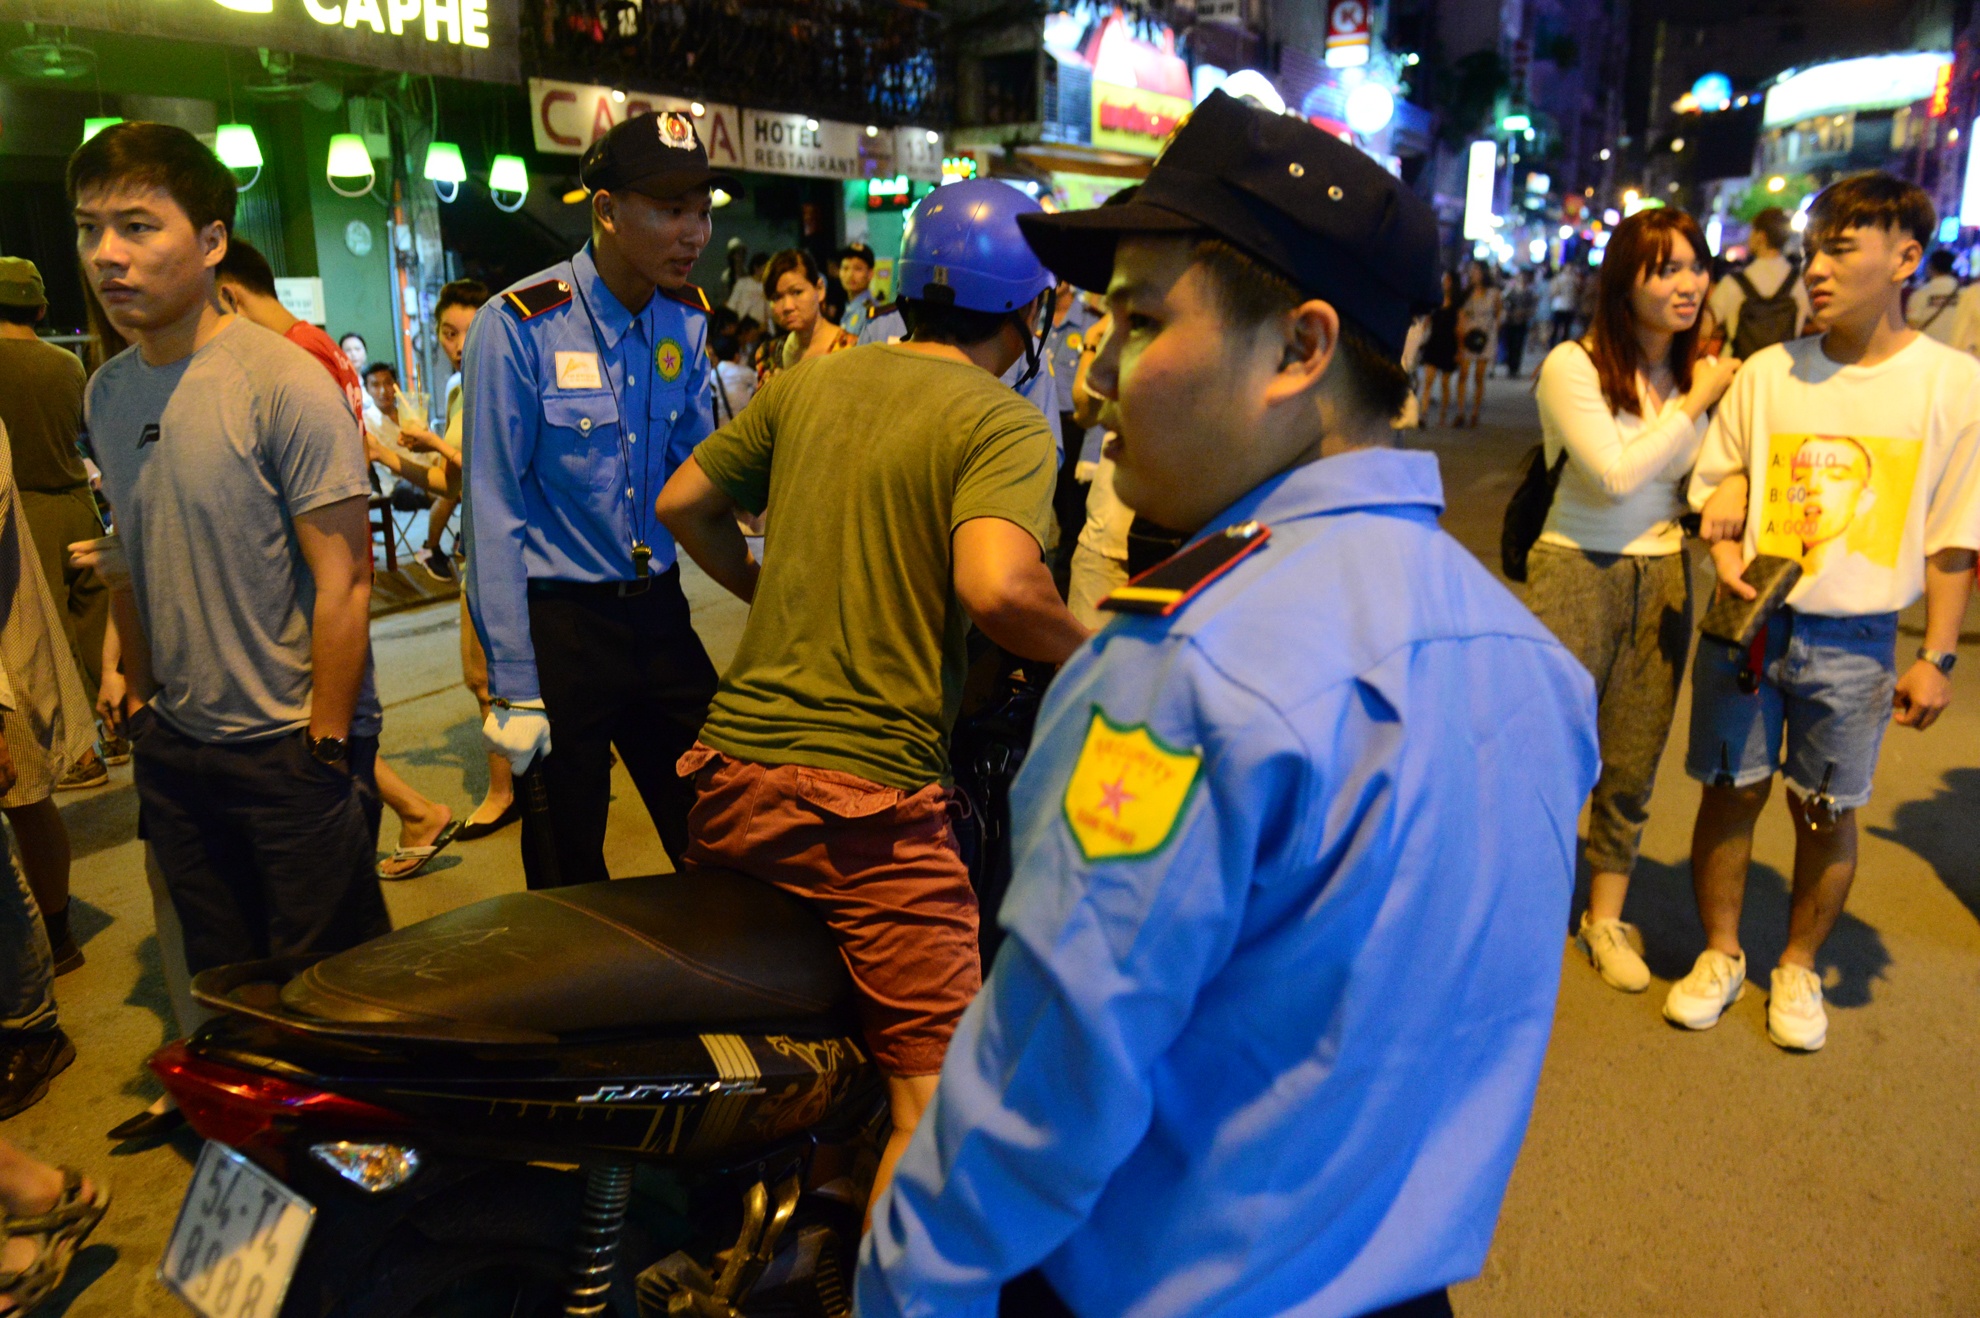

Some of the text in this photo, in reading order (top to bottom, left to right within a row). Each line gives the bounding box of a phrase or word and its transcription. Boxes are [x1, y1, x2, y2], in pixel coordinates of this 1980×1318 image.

[754, 118, 822, 149] HOTEL
[755, 149, 855, 173] RESTAURANT
[177, 1224, 264, 1318] 8988
